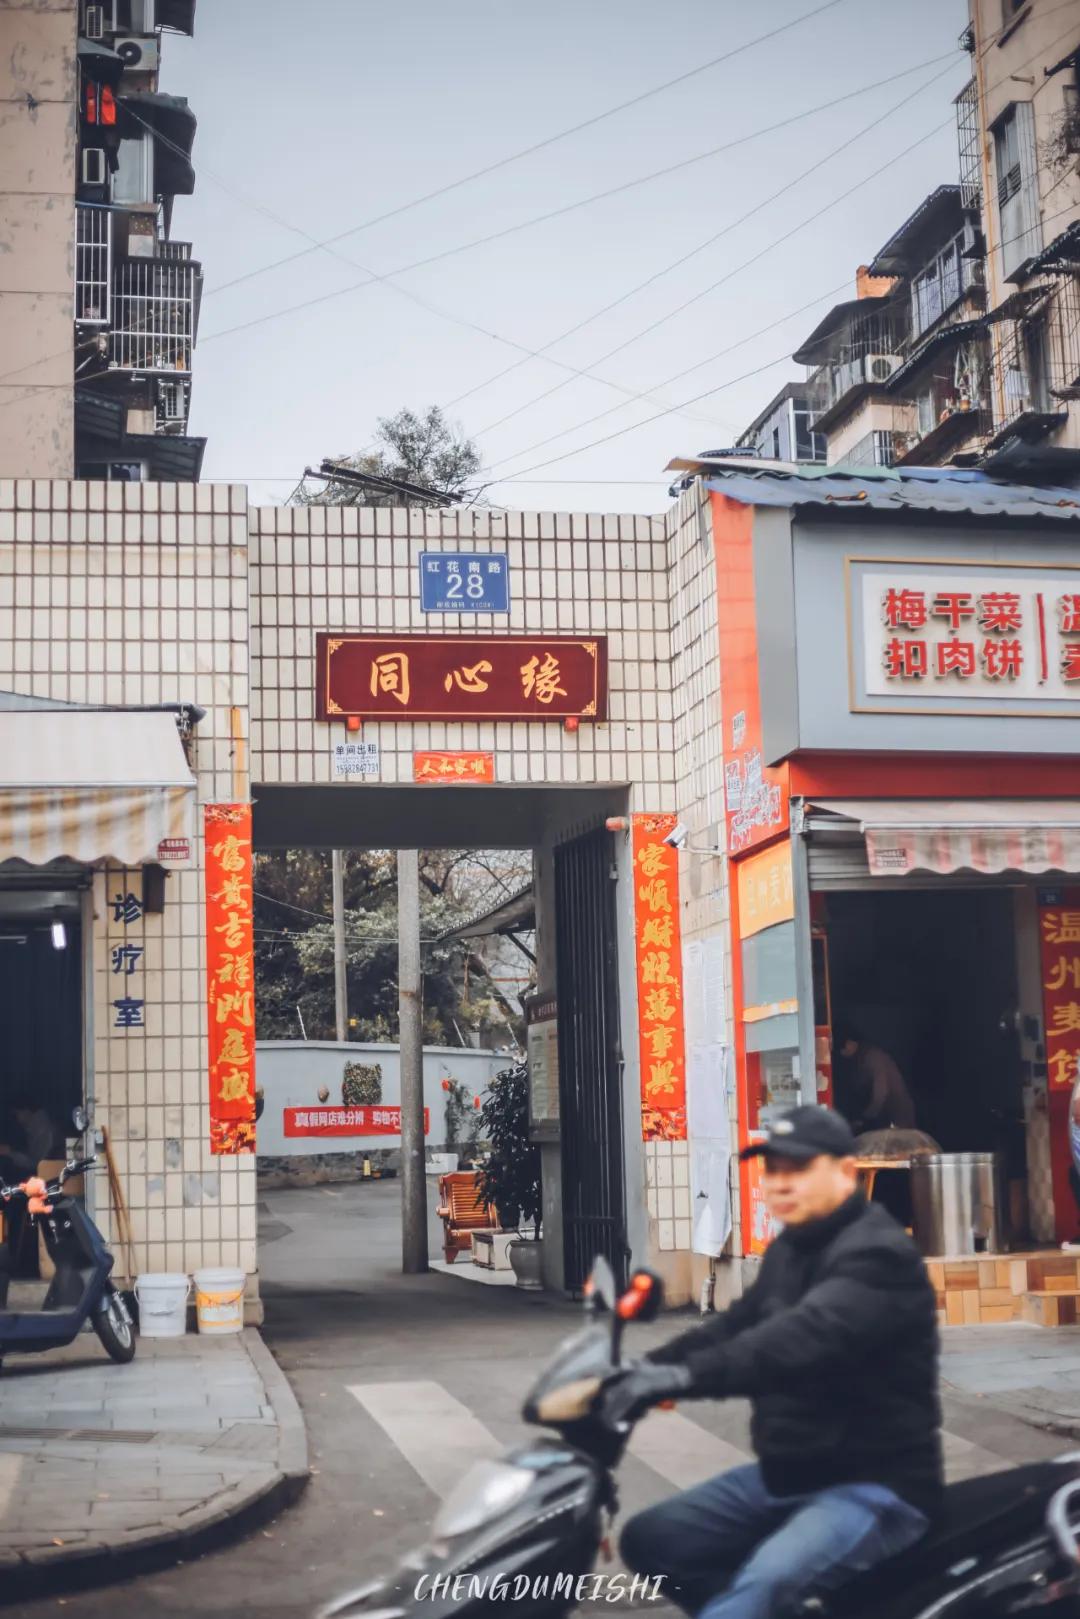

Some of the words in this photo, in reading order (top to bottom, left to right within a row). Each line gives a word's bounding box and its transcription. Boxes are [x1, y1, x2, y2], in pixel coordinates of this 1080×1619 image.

[427, 560, 501, 574] 红花南路
[446, 574, 484, 599] 28
[885, 588, 1024, 631] 梅干菜
[887, 638, 1025, 678] 扣肉饼
[369, 652, 568, 705] 同心缘
[336, 743, 377, 756] 单间出租
[111, 892, 145, 1028] 诊疗室
[372, 1110, 401, 1128] 购物不
